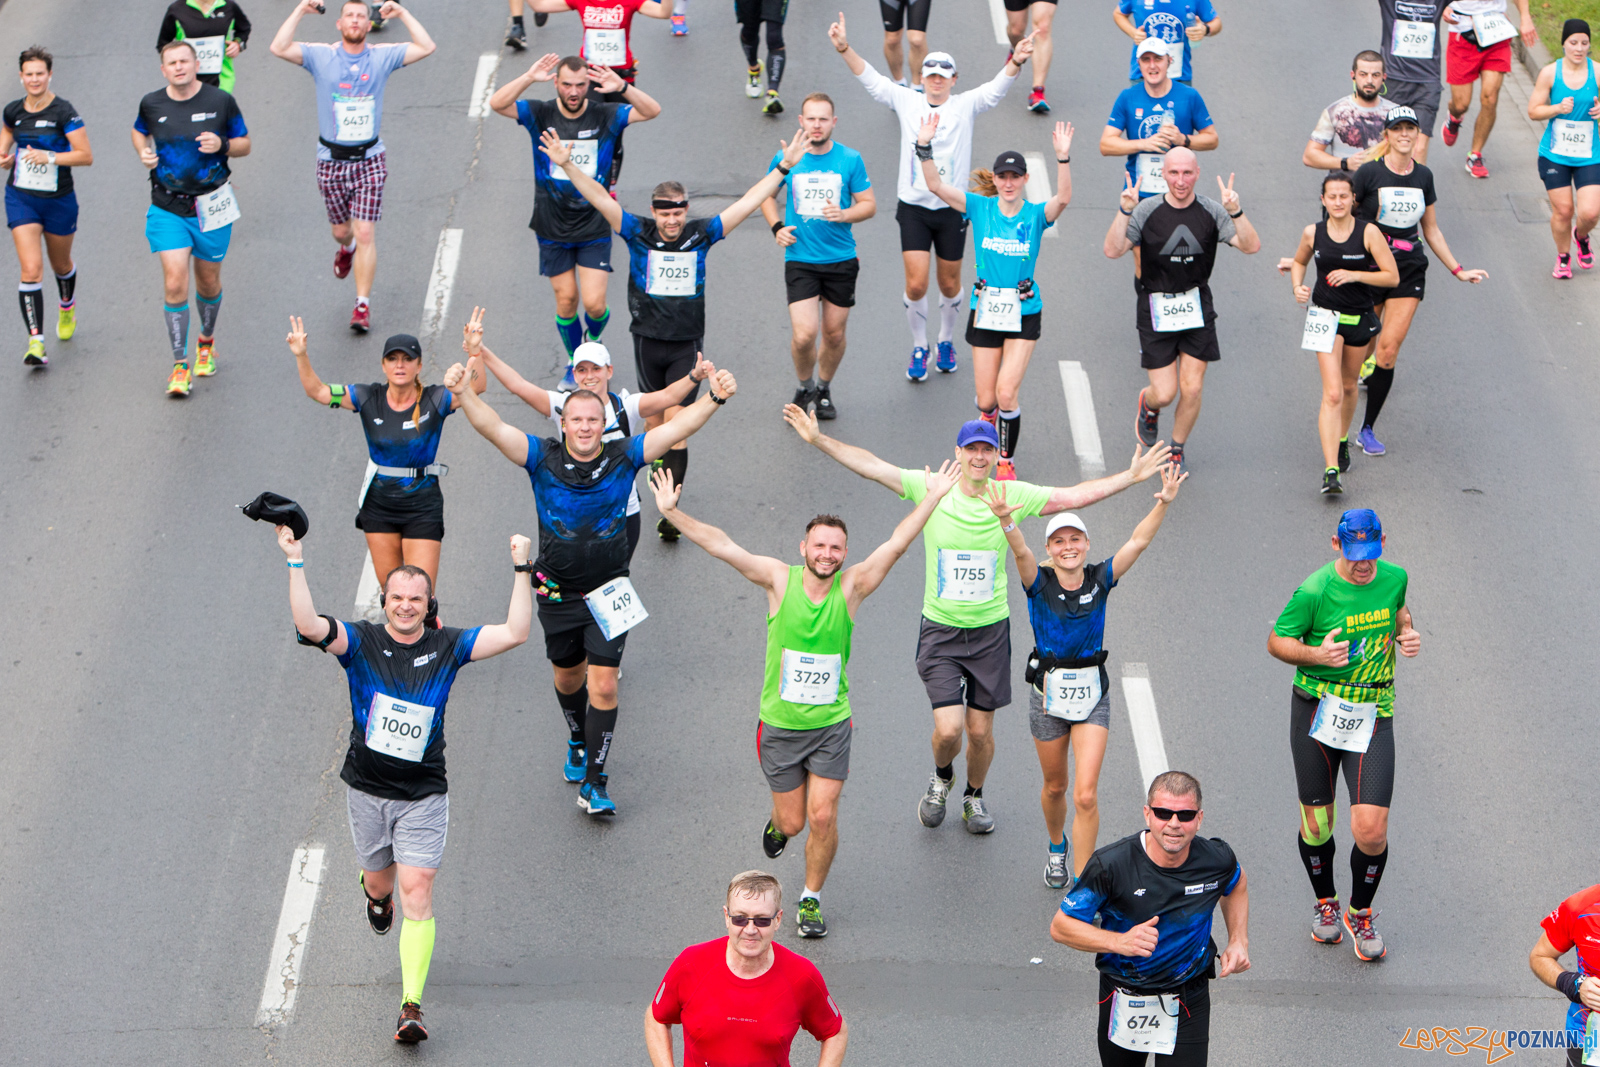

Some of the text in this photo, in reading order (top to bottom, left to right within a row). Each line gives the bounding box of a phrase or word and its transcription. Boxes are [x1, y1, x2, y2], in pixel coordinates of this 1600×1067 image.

[1403, 34, 1428, 44] 6769
[594, 42, 619, 52] 1056
[196, 50, 220, 60] 054
[1388, 106, 1417, 121] QUEEN
[343, 115, 369, 127] 6437
[1562, 132, 1586, 143] 1482
[26, 163, 48, 175] 960
[804, 189, 834, 200] 2750
[208, 197, 231, 217] 5459
[1390, 201, 1418, 213] 2239
[981, 237, 1030, 254] Bieganie
[658, 267, 690, 278] 7025
[988, 302, 1014, 314] 2677
[1163, 302, 1194, 316] 5645
[953, 568, 986, 581] 1755
[612, 592, 632, 612] 419
[1346, 608, 1390, 627] BIEGAM
[794, 669, 831, 685] 3729
[1059, 686, 1091, 700] 3731
[382, 716, 422, 739] 1000
[1332, 714, 1364, 731] 1387
[1134, 888, 1147, 897] 4F
[1127, 1015, 1161, 1029] 674
